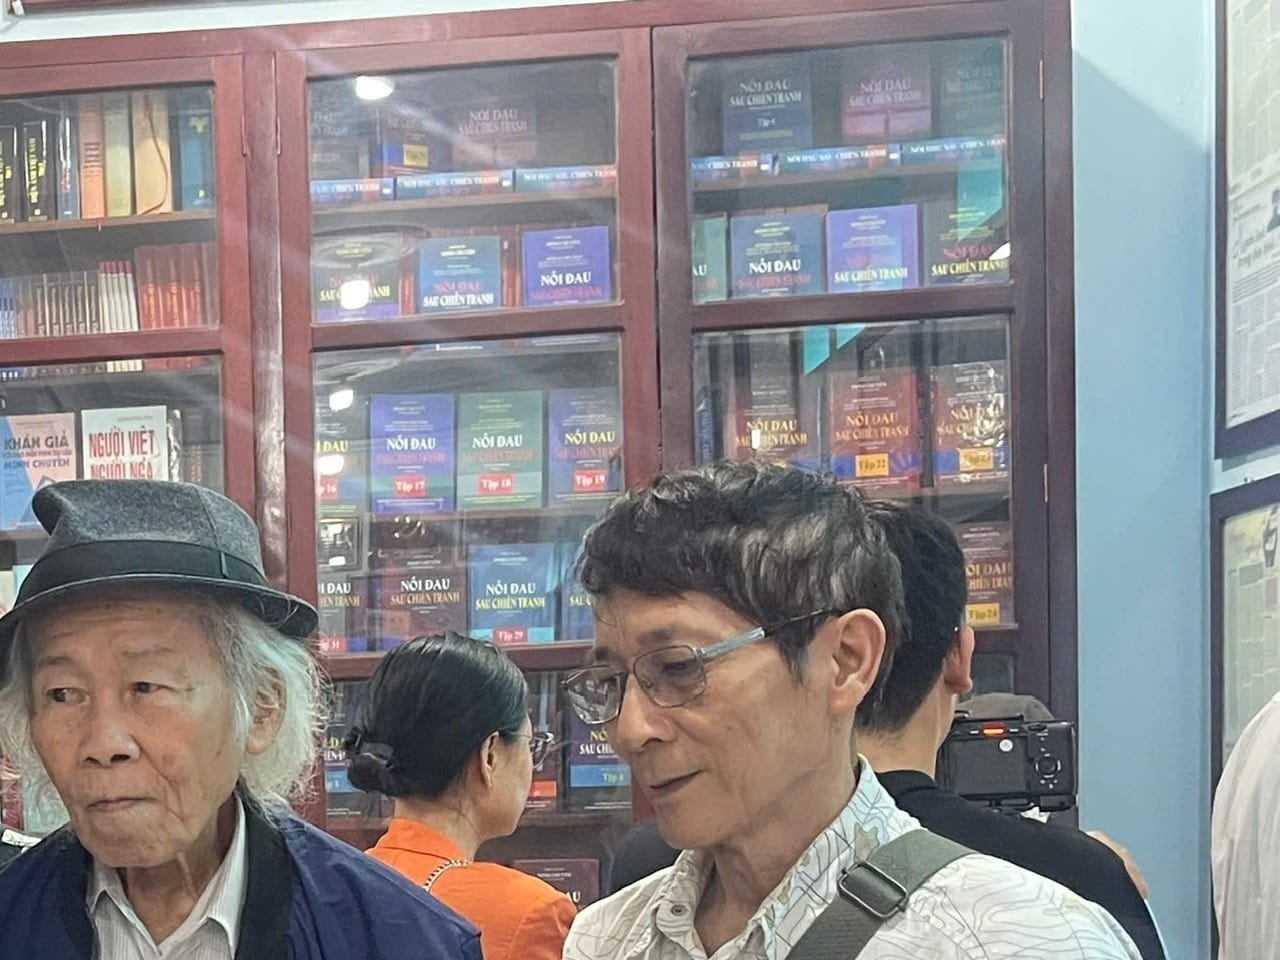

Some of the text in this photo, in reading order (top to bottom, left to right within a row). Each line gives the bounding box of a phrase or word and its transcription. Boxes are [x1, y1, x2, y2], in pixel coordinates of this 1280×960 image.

[764, 79, 791, 92] ĐAU
[774, 259, 801, 273] ĐAU
[931, 264, 948, 276] SAU
[566, 271, 592, 284] ĐAU
[834, 271, 852, 284] SAU
[879, 267, 908, 280] TRANH
[466, 293, 494, 306] TRANH
[871, 411, 899, 425] ĐAU
[771, 419, 797, 432] ĐAU
[881, 424, 909, 438] TRANH
[89, 425, 155, 461] NGƯỜI VIỆT
[410, 437, 436, 450] ĐAU
[497, 434, 523, 448] ĐAU
[589, 431, 615, 444] ĐAU
[324, 439, 349, 453] ĐAU
[859, 460, 875, 474] Tập
[395, 480, 425, 493] Tập 17
[481, 479, 498, 491] Tập
[576, 474, 593, 487] Tập
[327, 581, 351, 594] ĐAU
[425, 577, 451, 591] ĐAU
[510, 582, 536, 594] ĐAU
[433, 591, 460, 604] TRANH
[476, 598, 492, 610] SAU
[519, 596, 545, 608] TRANH
[498, 628, 524, 642] Tập 29
[579, 744, 596, 756] SAU
